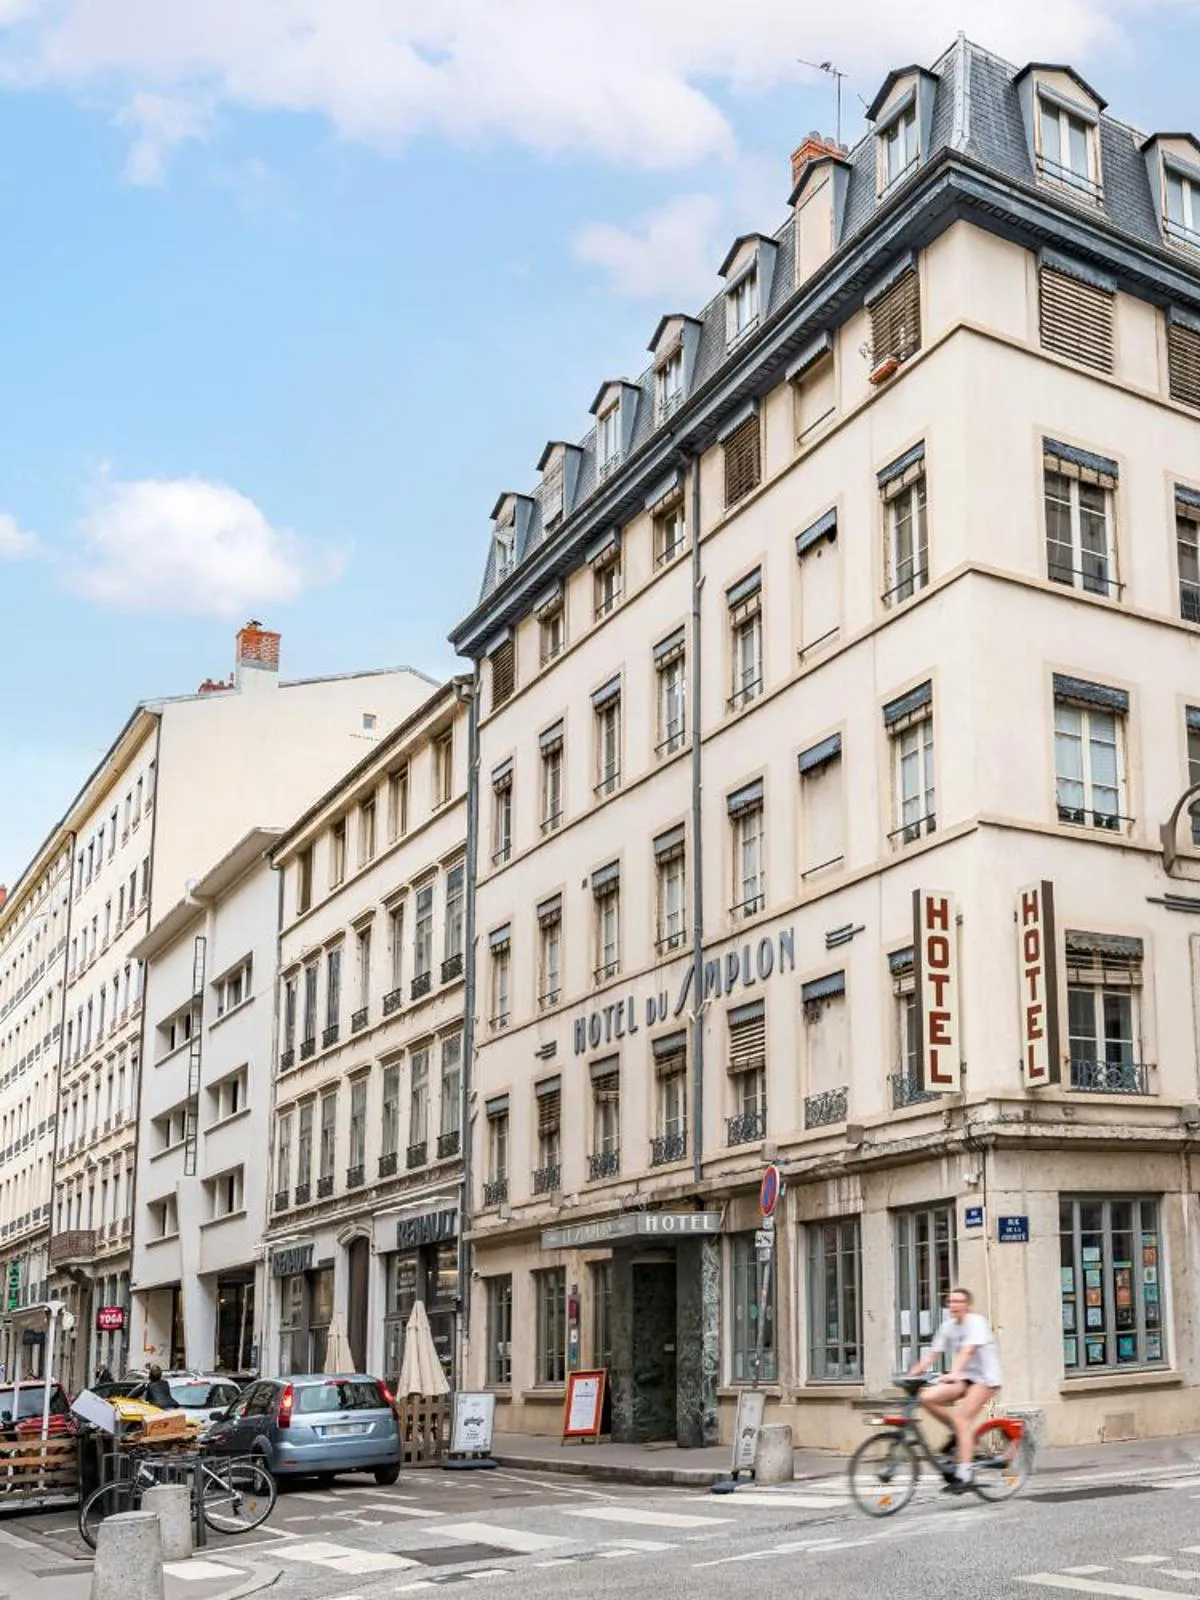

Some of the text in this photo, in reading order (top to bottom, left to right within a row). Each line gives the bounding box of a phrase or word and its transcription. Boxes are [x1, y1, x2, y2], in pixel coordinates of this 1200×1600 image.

[573, 926, 796, 1057] HOTEL DU SMPLON
[926, 896, 953, 1085] HOTEL
[1022, 890, 1045, 1080] HOTEL
[397, 1207, 458, 1250] RENAULT
[645, 1214, 714, 1232] HOTEL
[100, 1313, 123, 1323] YOGA
